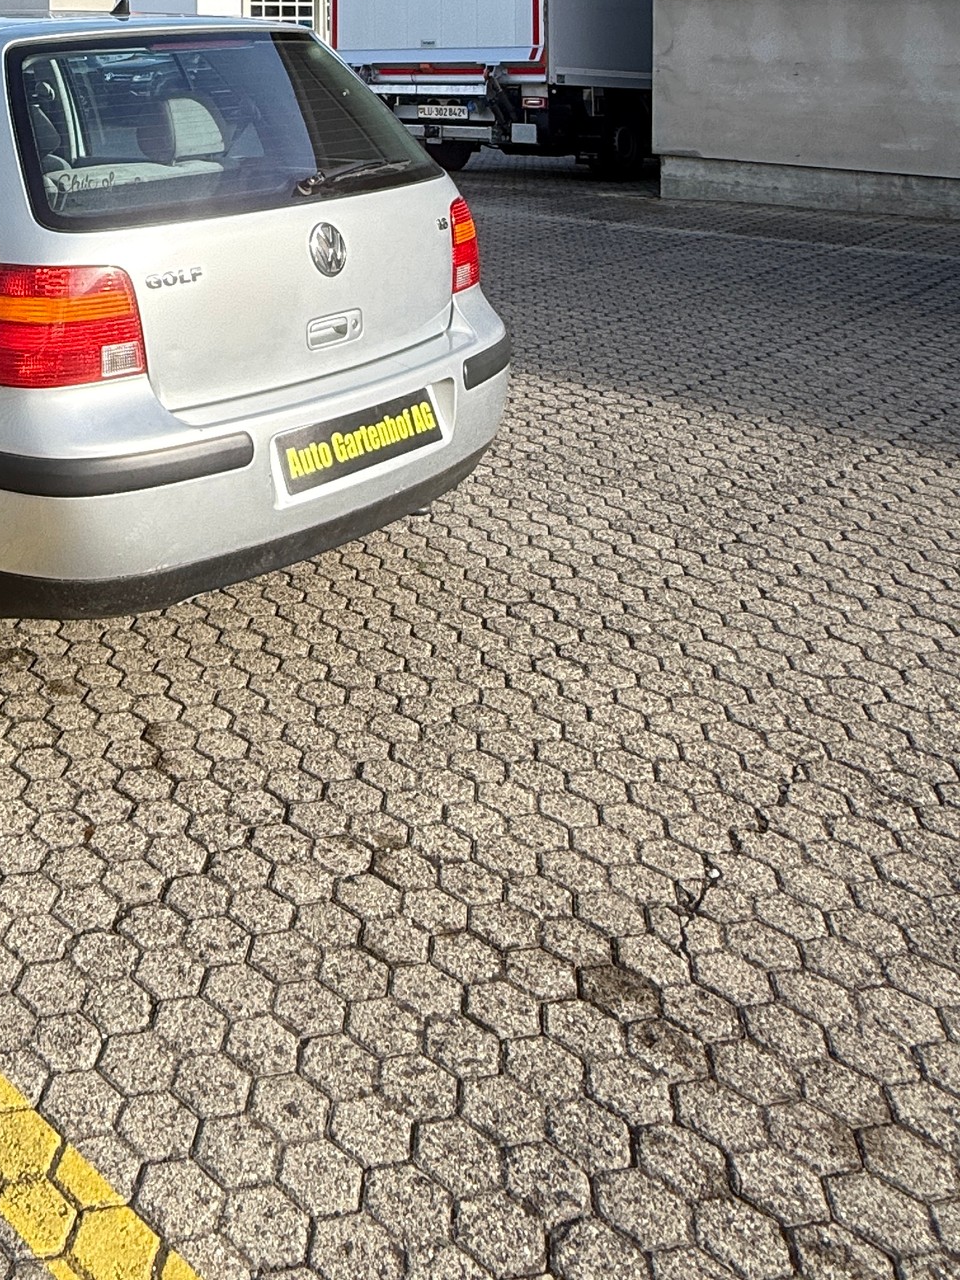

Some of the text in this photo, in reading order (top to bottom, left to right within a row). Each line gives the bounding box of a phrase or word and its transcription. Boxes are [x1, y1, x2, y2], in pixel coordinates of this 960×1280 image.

[145, 266, 203, 289] GOLF
[286, 401, 437, 479] Auto Gartenhof AG
